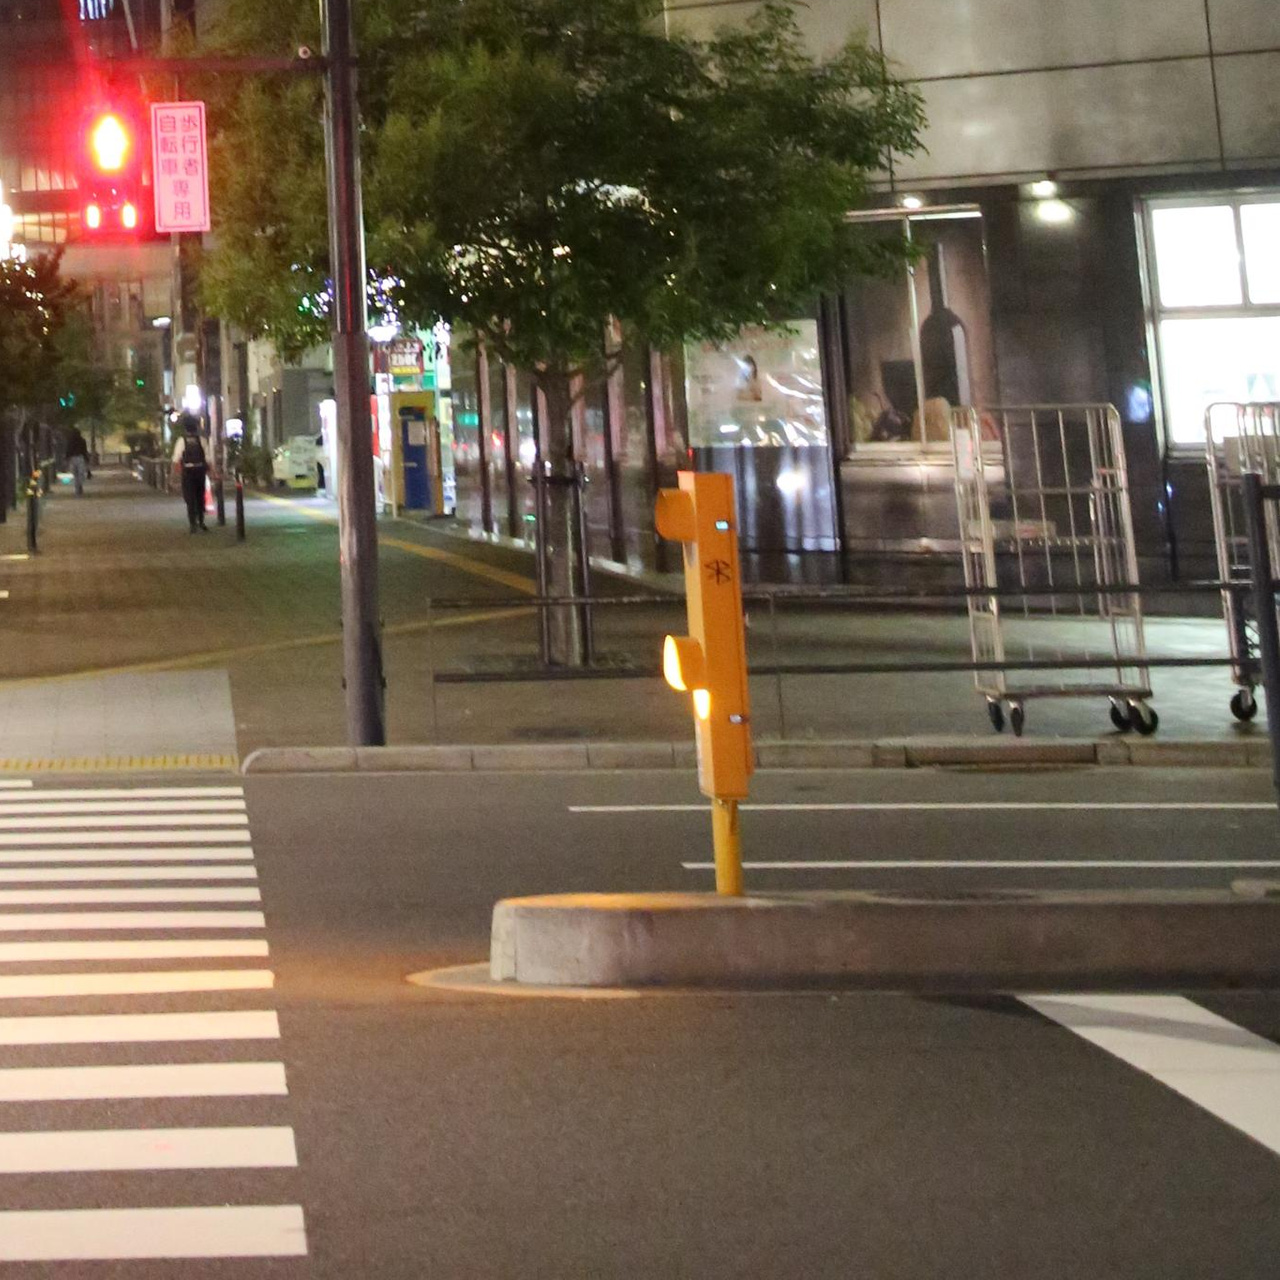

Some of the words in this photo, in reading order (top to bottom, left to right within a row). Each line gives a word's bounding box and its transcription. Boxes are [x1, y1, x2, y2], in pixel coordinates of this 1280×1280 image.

[159, 115, 178, 177] 自転車
[181, 114, 199, 177] 歩行者
[173, 180, 191, 220] 専用
